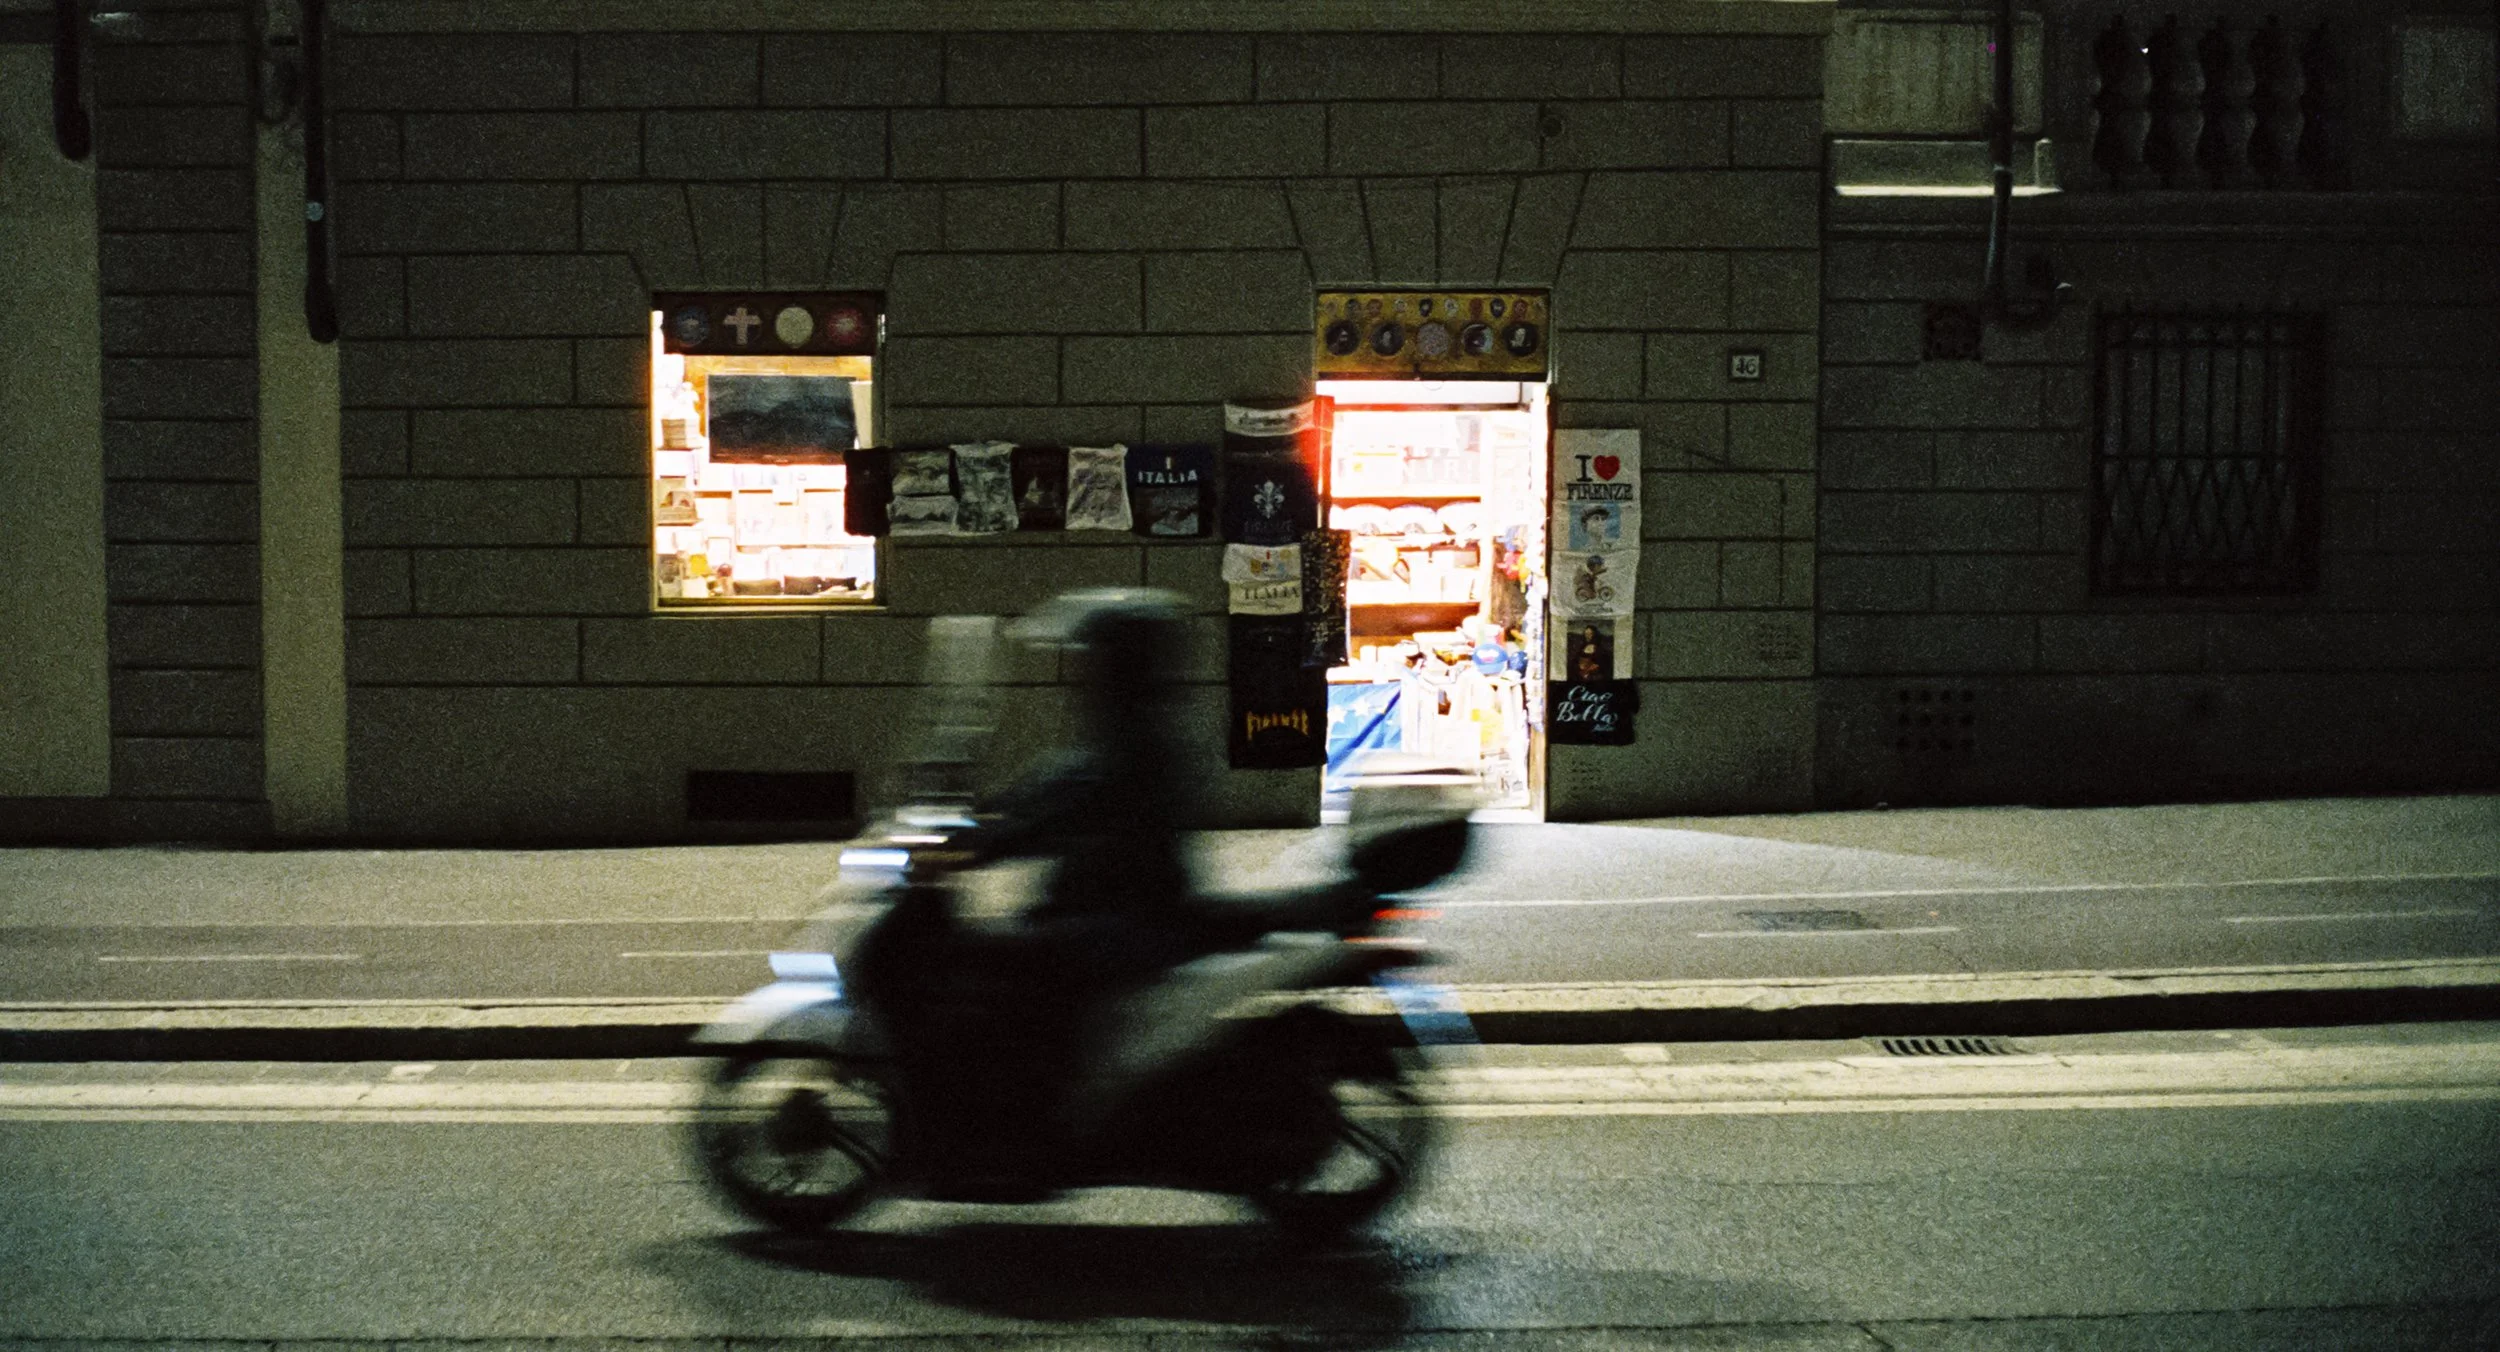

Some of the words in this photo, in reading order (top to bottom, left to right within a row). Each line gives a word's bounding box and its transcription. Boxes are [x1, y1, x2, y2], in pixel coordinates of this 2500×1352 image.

[1138, 469, 1198, 484] ITALIA
[1575, 454, 1593, 482] I
[1566, 483, 1633, 500] FIRENZE
[1568, 685, 1613, 703] Ciao
[1556, 701, 1618, 724] Bella
